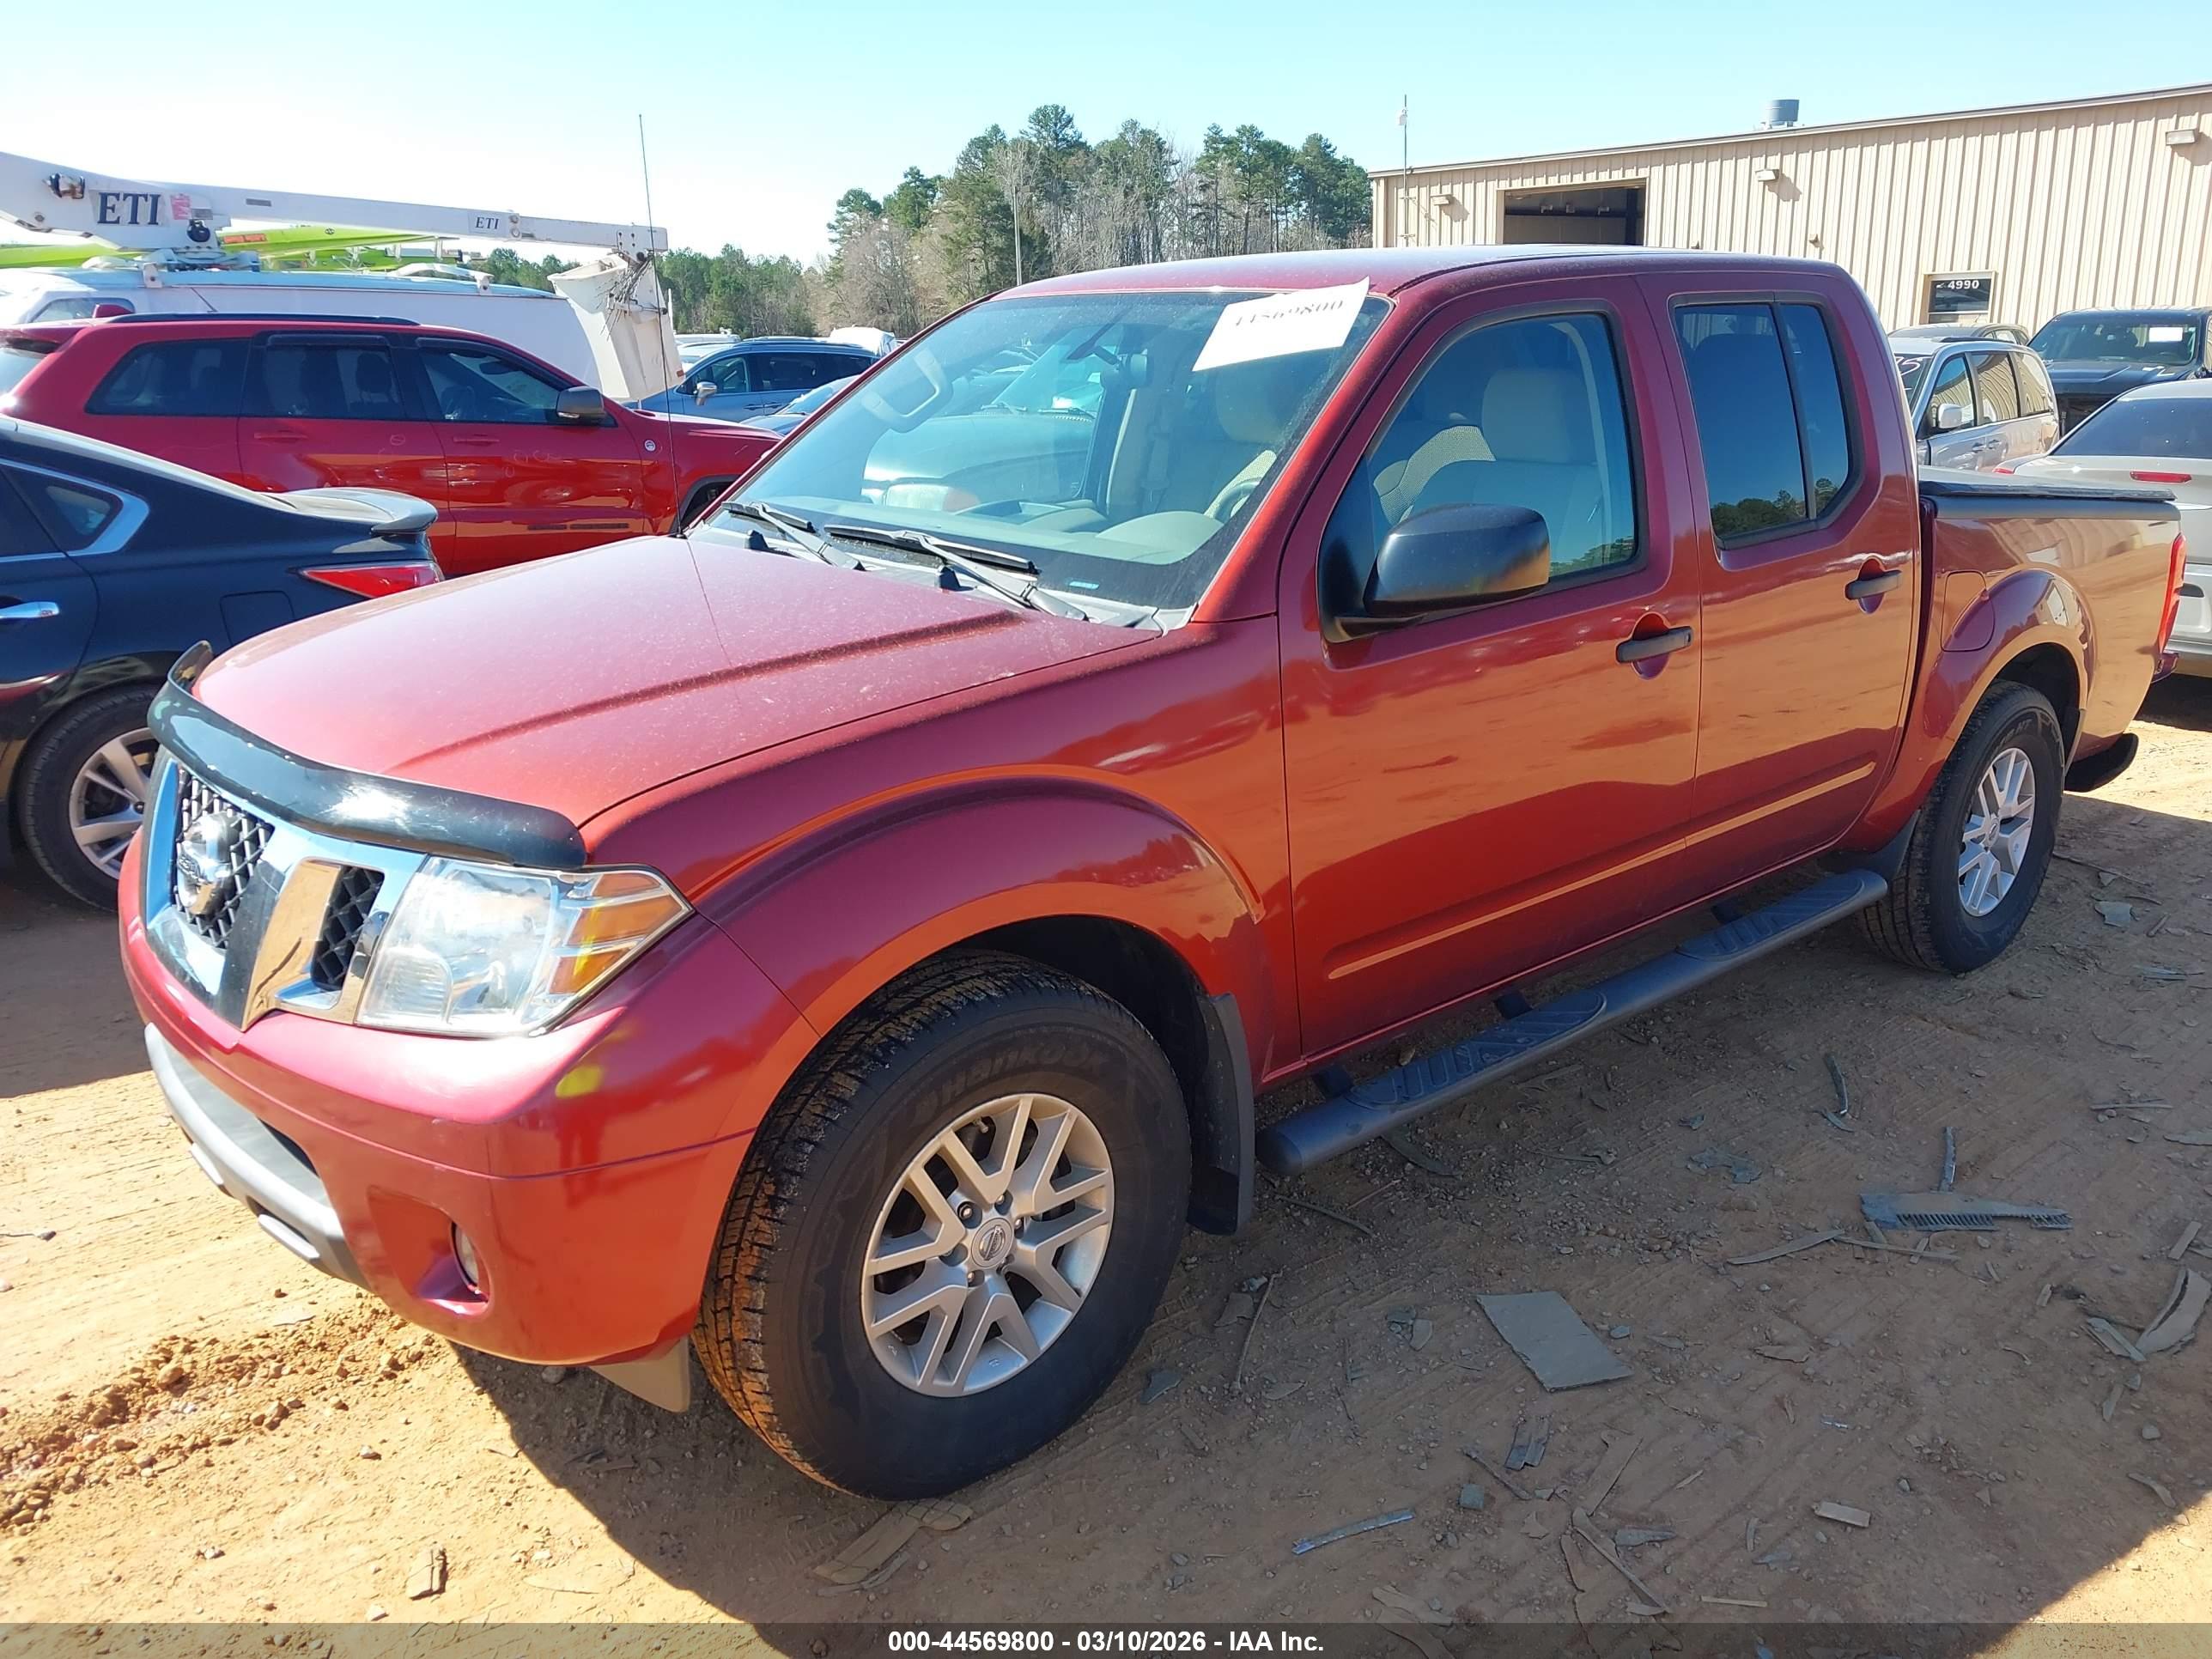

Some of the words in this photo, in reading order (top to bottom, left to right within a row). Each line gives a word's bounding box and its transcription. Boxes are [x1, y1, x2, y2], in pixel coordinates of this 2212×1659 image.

[97, 191, 161, 226] ETI
[475, 216, 500, 230] ETI
[1948, 280, 1980, 289] 4990
